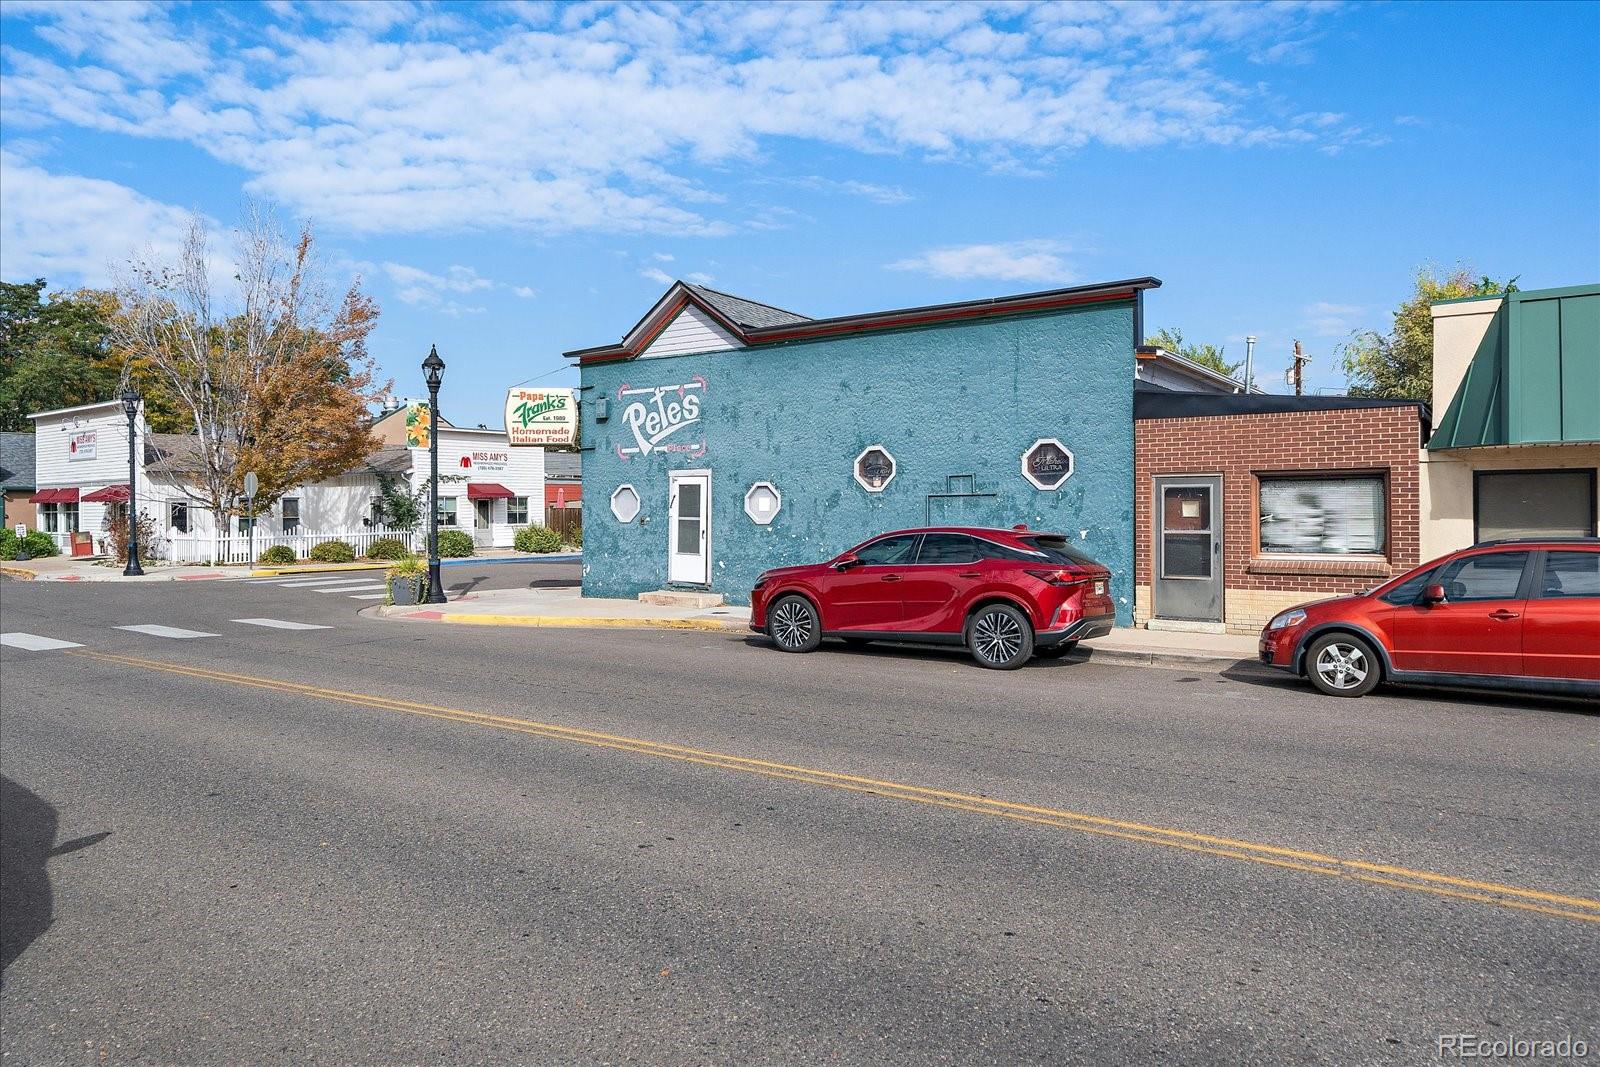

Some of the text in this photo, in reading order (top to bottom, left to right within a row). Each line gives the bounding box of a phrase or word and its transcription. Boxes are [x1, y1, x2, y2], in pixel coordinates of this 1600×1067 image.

[519, 391, 545, 402] Papa
[513, 393, 567, 429] Frank's
[512, 427, 570, 435] Homemade
[472, 452, 508, 462] MISS AMY'S
